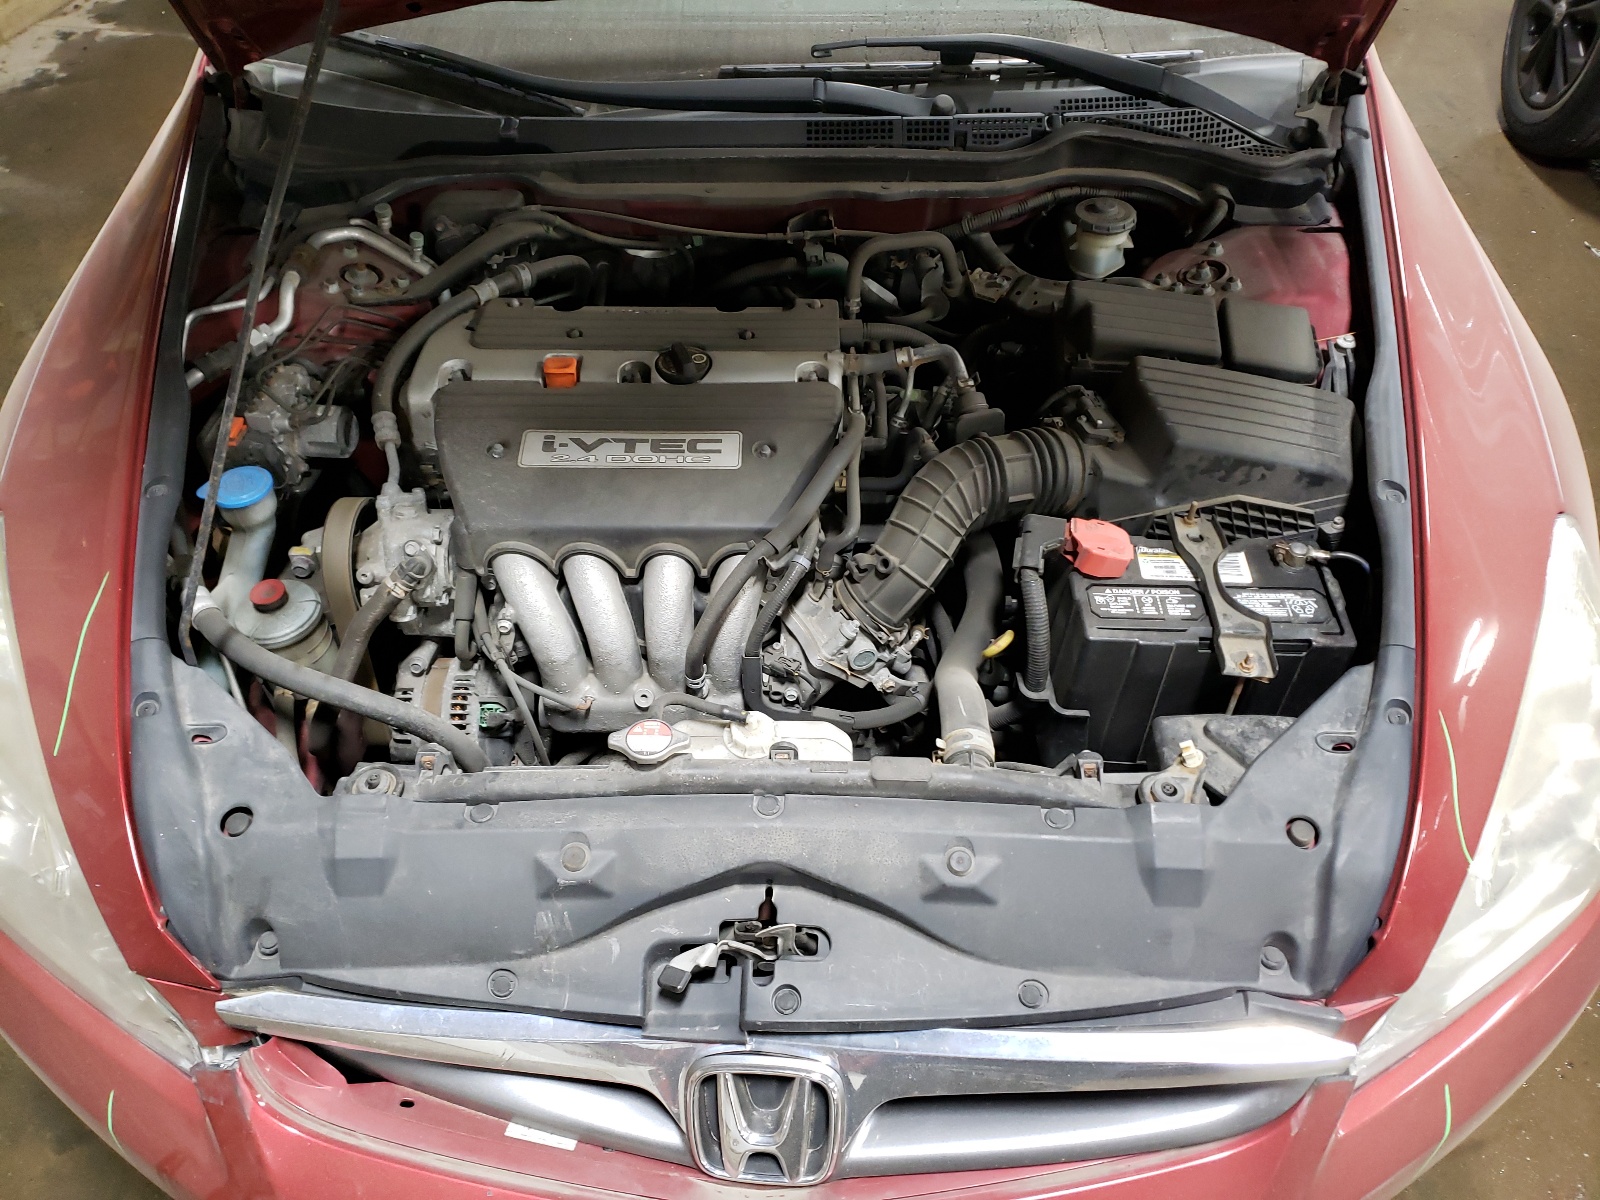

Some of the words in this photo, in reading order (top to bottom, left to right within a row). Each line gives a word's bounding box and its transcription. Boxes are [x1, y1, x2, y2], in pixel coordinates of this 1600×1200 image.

[541, 434, 723, 454] i-VTEC
[550, 454, 599, 463] 2.4
[605, 455, 712, 464] DOHC
